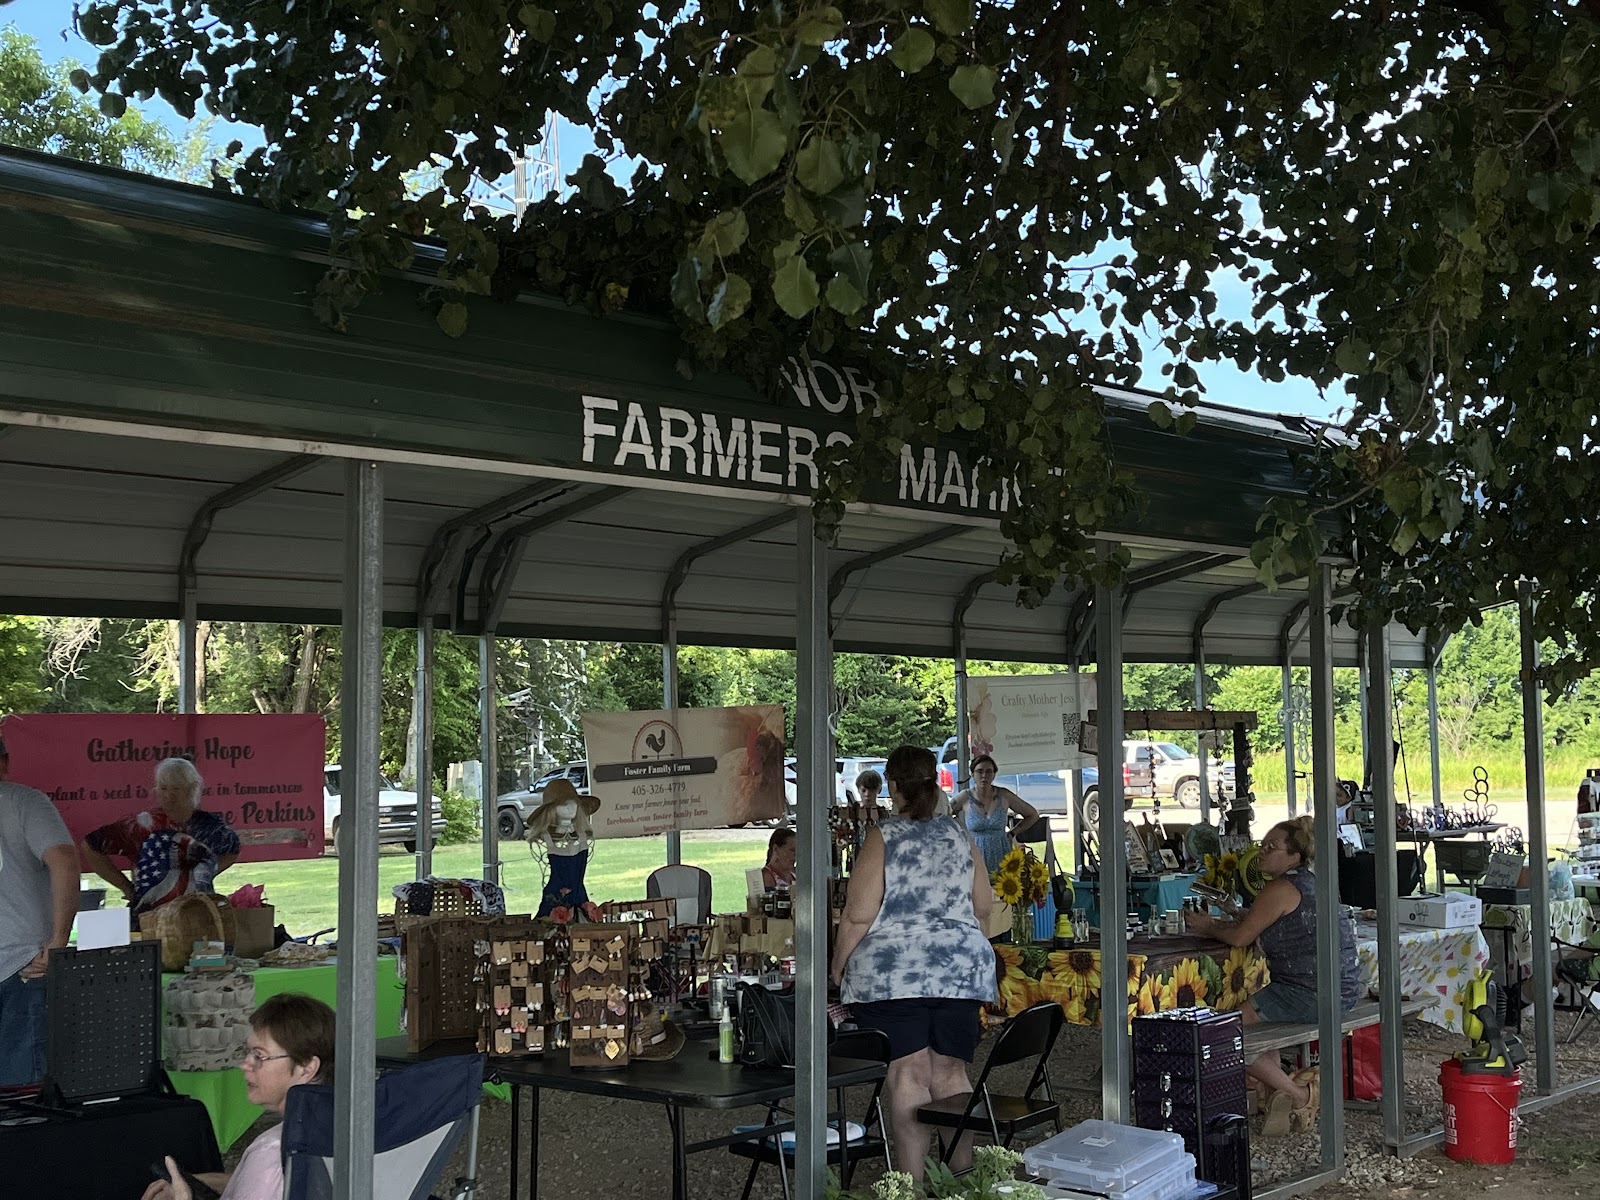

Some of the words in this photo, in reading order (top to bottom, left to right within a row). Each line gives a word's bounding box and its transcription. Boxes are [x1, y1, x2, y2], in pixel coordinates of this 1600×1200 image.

[1001, 693, 1027, 709] Crafty
[1028, 692, 1058, 705] Mother
[1058, 692, 1075, 708] Jess
[204, 737, 255, 768] Hope
[624, 766, 647, 776] Foster
[648, 764, 671, 774] Family
[673, 763, 691, 772] Farm
[103, 785, 133, 800] seed
[136, 786, 150, 799] is
[216, 783, 231, 796] in
[632, 781, 686, 796] 405-326-4779
[241, 801, 316, 824] Perkins
